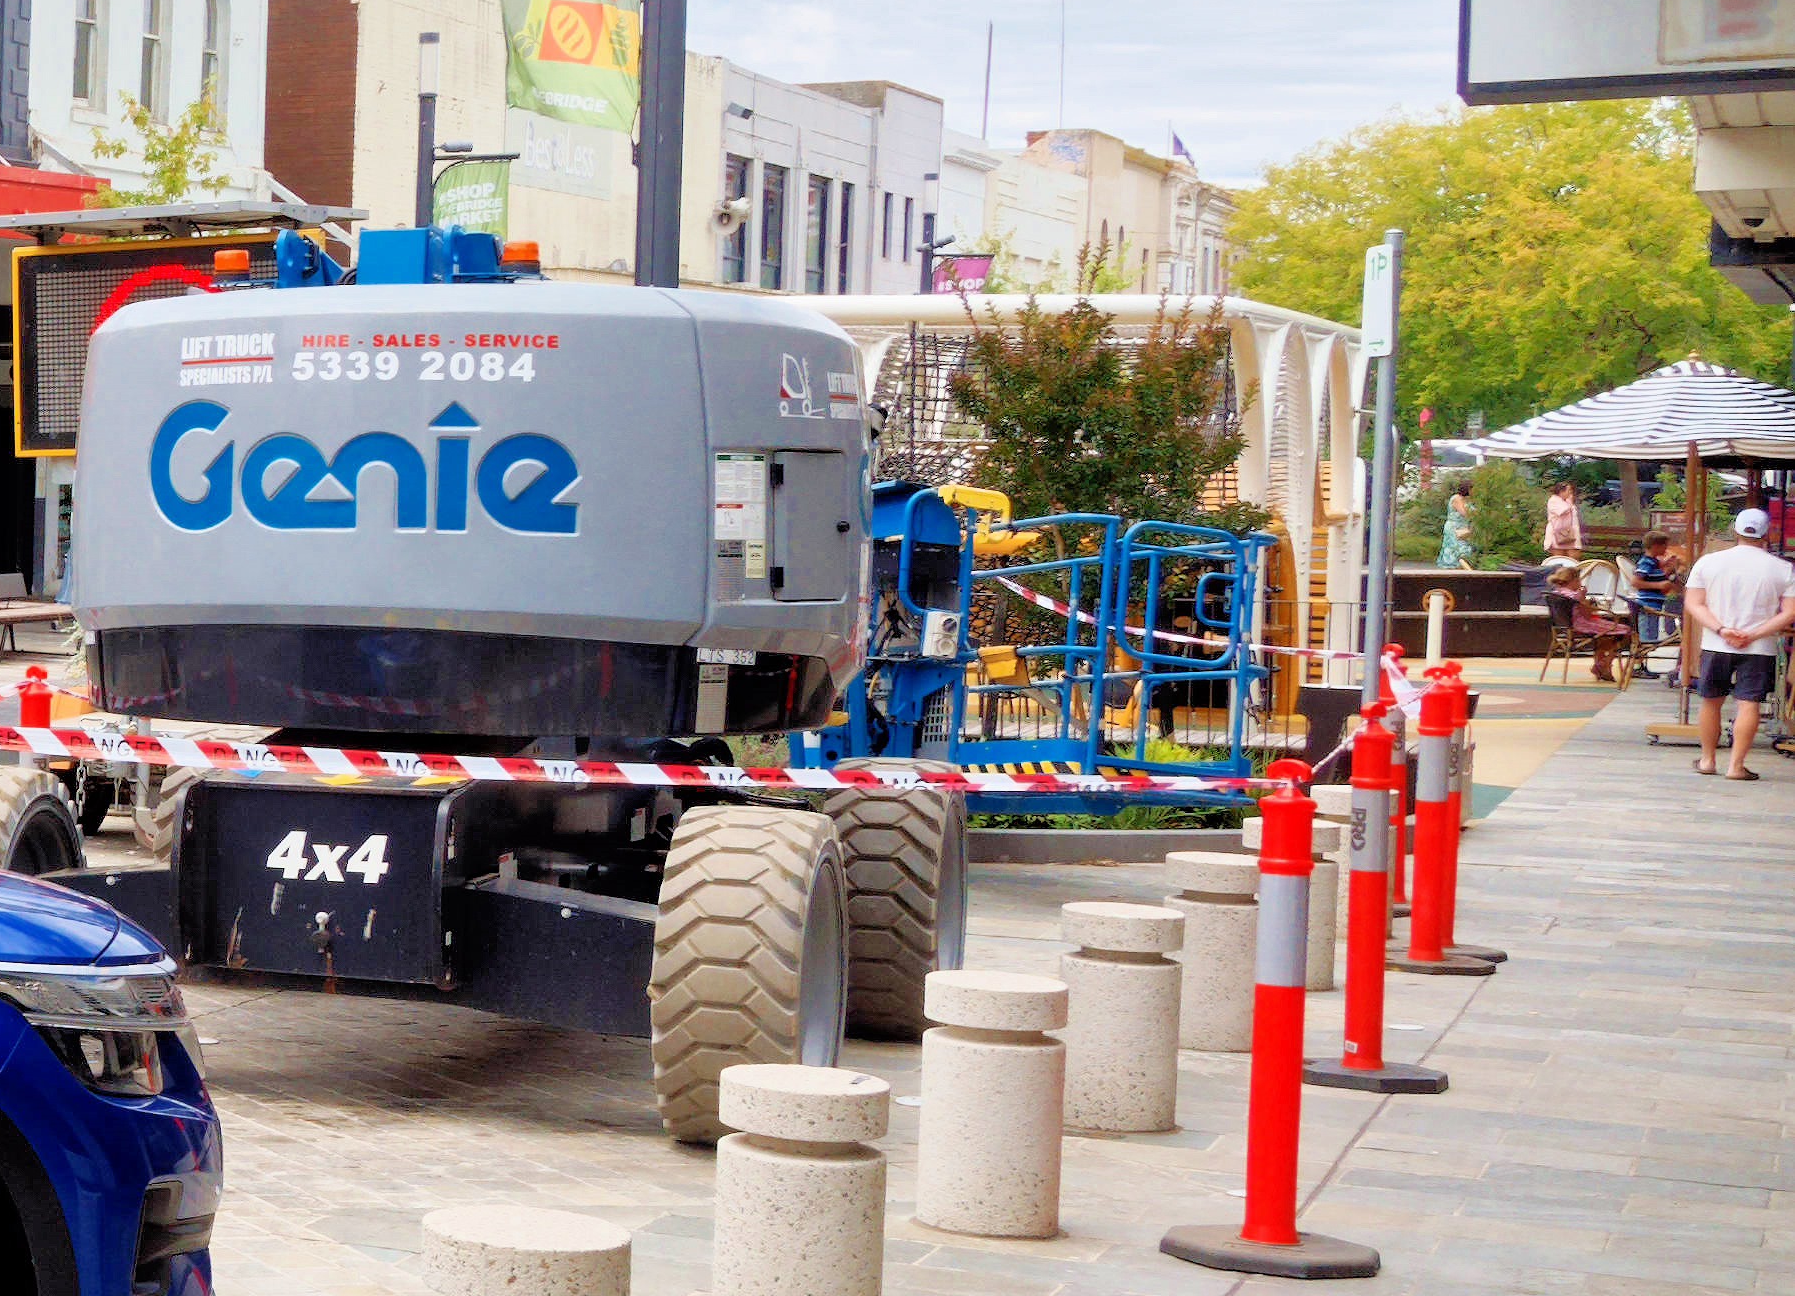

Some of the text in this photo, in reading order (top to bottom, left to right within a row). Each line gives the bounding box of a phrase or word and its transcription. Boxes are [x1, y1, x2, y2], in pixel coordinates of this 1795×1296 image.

[181, 333, 275, 360] LIFT TRUCK
[302, 334, 350, 348] HIRE
[372, 334, 440, 348] SALES
[464, 334, 559, 348] SERVICE
[180, 367, 250, 387] SPECIALISTS
[291, 351, 536, 382] 5339 2084
[149, 398, 582, 537] Genie
[70, 735, 165, 756] DANGER
[213, 747, 311, 765] DANGER
[266, 830, 389, 884] 4x4
